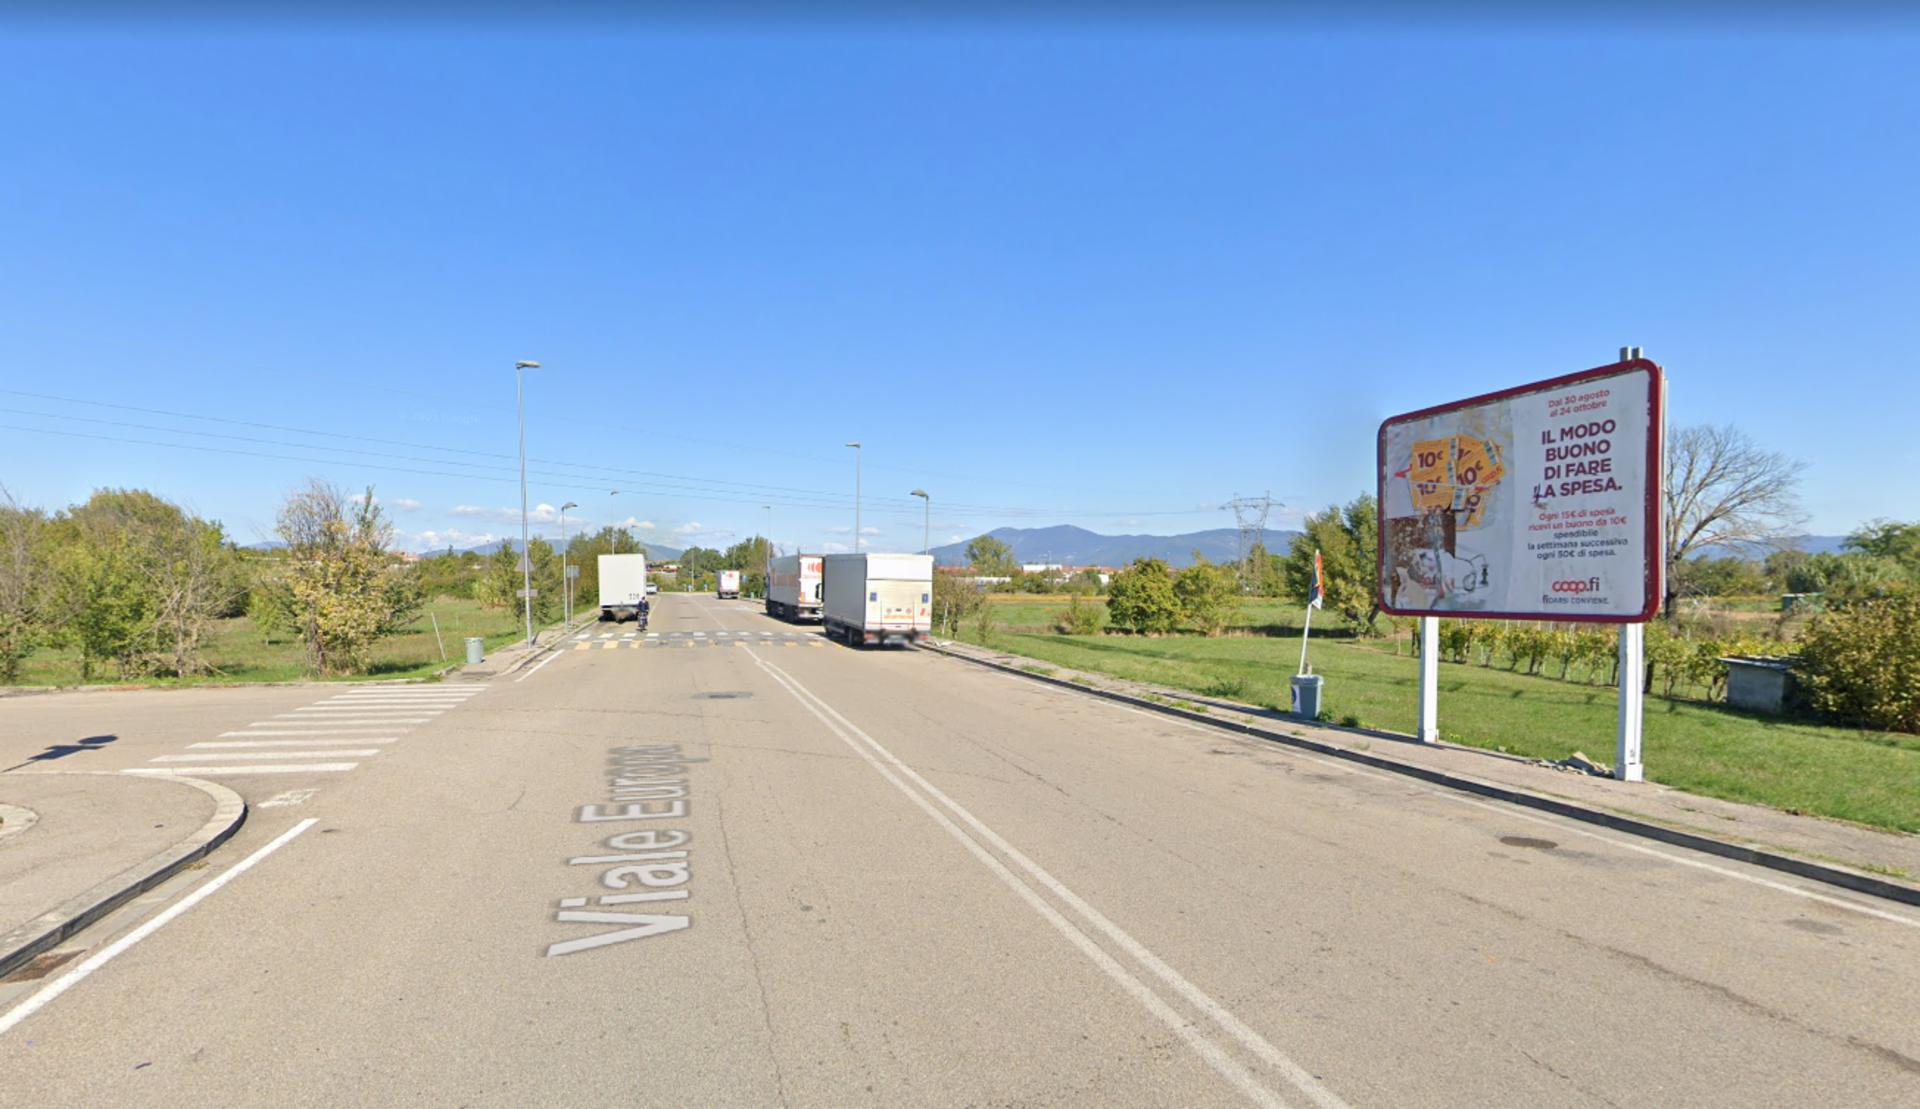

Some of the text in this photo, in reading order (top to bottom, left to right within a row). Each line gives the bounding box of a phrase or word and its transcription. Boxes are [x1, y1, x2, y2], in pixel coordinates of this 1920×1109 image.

[1541, 419, 1616, 445] IL MODO
[1418, 450, 1444, 468] 10€
[1545, 439, 1611, 462] BUONO
[1544, 457, 1612, 481] DI FARE
[1560, 476, 1623, 497] SPESA.
[1539, 512, 1559, 521] Ogni
[1578, 509, 1587, 518] di
[1589, 508, 1616, 518] spesa
[1552, 522, 1563, 530] un
[1565, 519, 1593, 529] buono
[1528, 542, 1535, 550] la
[1537, 540, 1578, 550] settimana
[1537, 551, 1556, 560] ogni
[1577, 549, 1586, 558] di
[1552, 576, 1600, 594] coop.fi
